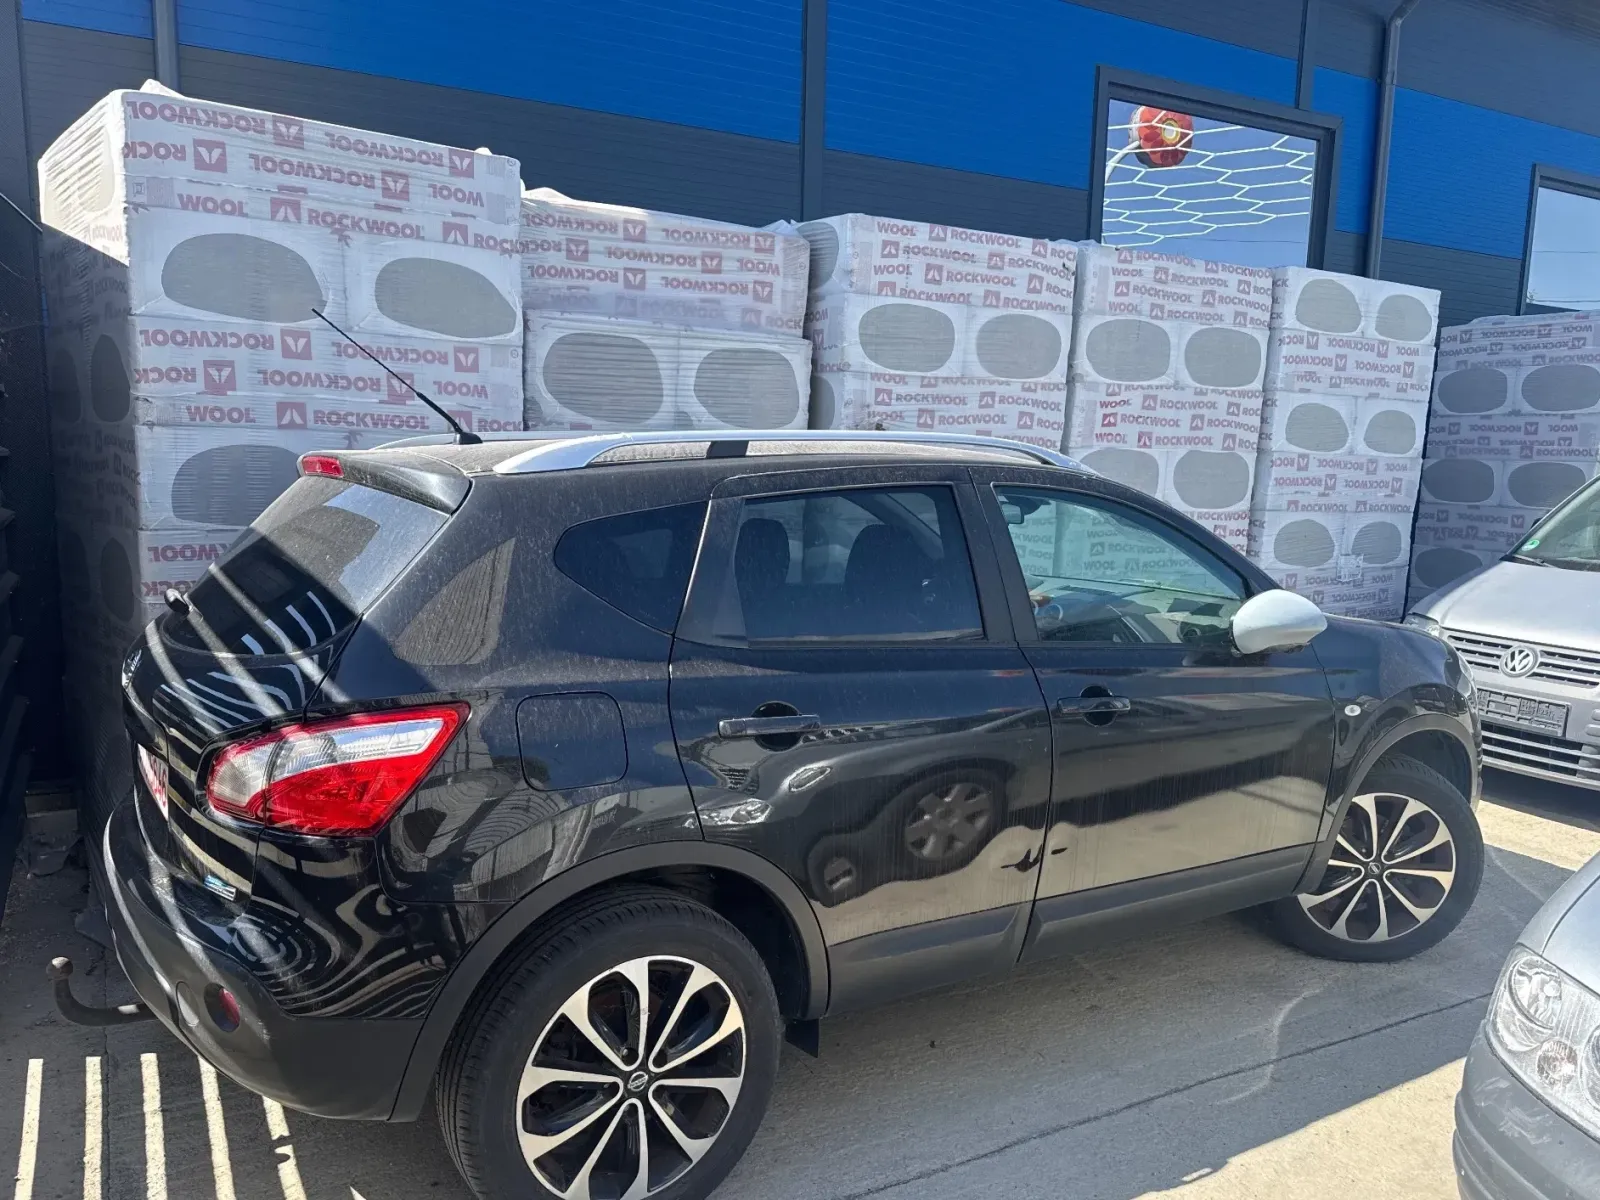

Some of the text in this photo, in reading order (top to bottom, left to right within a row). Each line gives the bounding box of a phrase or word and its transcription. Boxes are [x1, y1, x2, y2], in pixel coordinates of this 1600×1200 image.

[126, 101, 445, 167] ROCKWOOL ROCKWOOL
[123, 141, 485, 207] WOOL ROCKWOOL ROCK
[177, 193, 248, 217] WOOL
[307, 208, 425, 240] ROCKWOOL
[523, 213, 750, 248] ROCKWOOL ROCKWOOL
[877, 221, 916, 236] WOOL
[951, 229, 1020, 248] ROCKWOOL
[605, 246, 696, 267] ROCKWOOL
[736, 258, 780, 276] WOOL
[903, 245, 1071, 281] ROCKWOOL ROCKWOOL
[528, 265, 748, 295] ROCKWOOL ROCKWOOL
[874, 263, 912, 275] WOOL
[946, 270, 1016, 287] ROCKWOOL
[900, 288, 972, 304] ROCKWOOL
[1132, 285, 1193, 302] ROCKWOOL
[139, 328, 448, 365] ROCKWOOL ROCKWOOL
[133, 366, 488, 399] WOOL ROCKWOOL ROCK
[895, 393, 1061, 412] ROCKWOOL ROCKWOOL
[1159, 399, 1218, 410] ROCKWOOL
[186, 405, 256, 424] WOOL
[313, 409, 429, 430] ROCKWOOL
[938, 414, 1007, 425] ROCKWOOL
[1120, 413, 1181, 427] ROCKWOOL
[1155, 435, 1214, 446] ROCKWOOL
